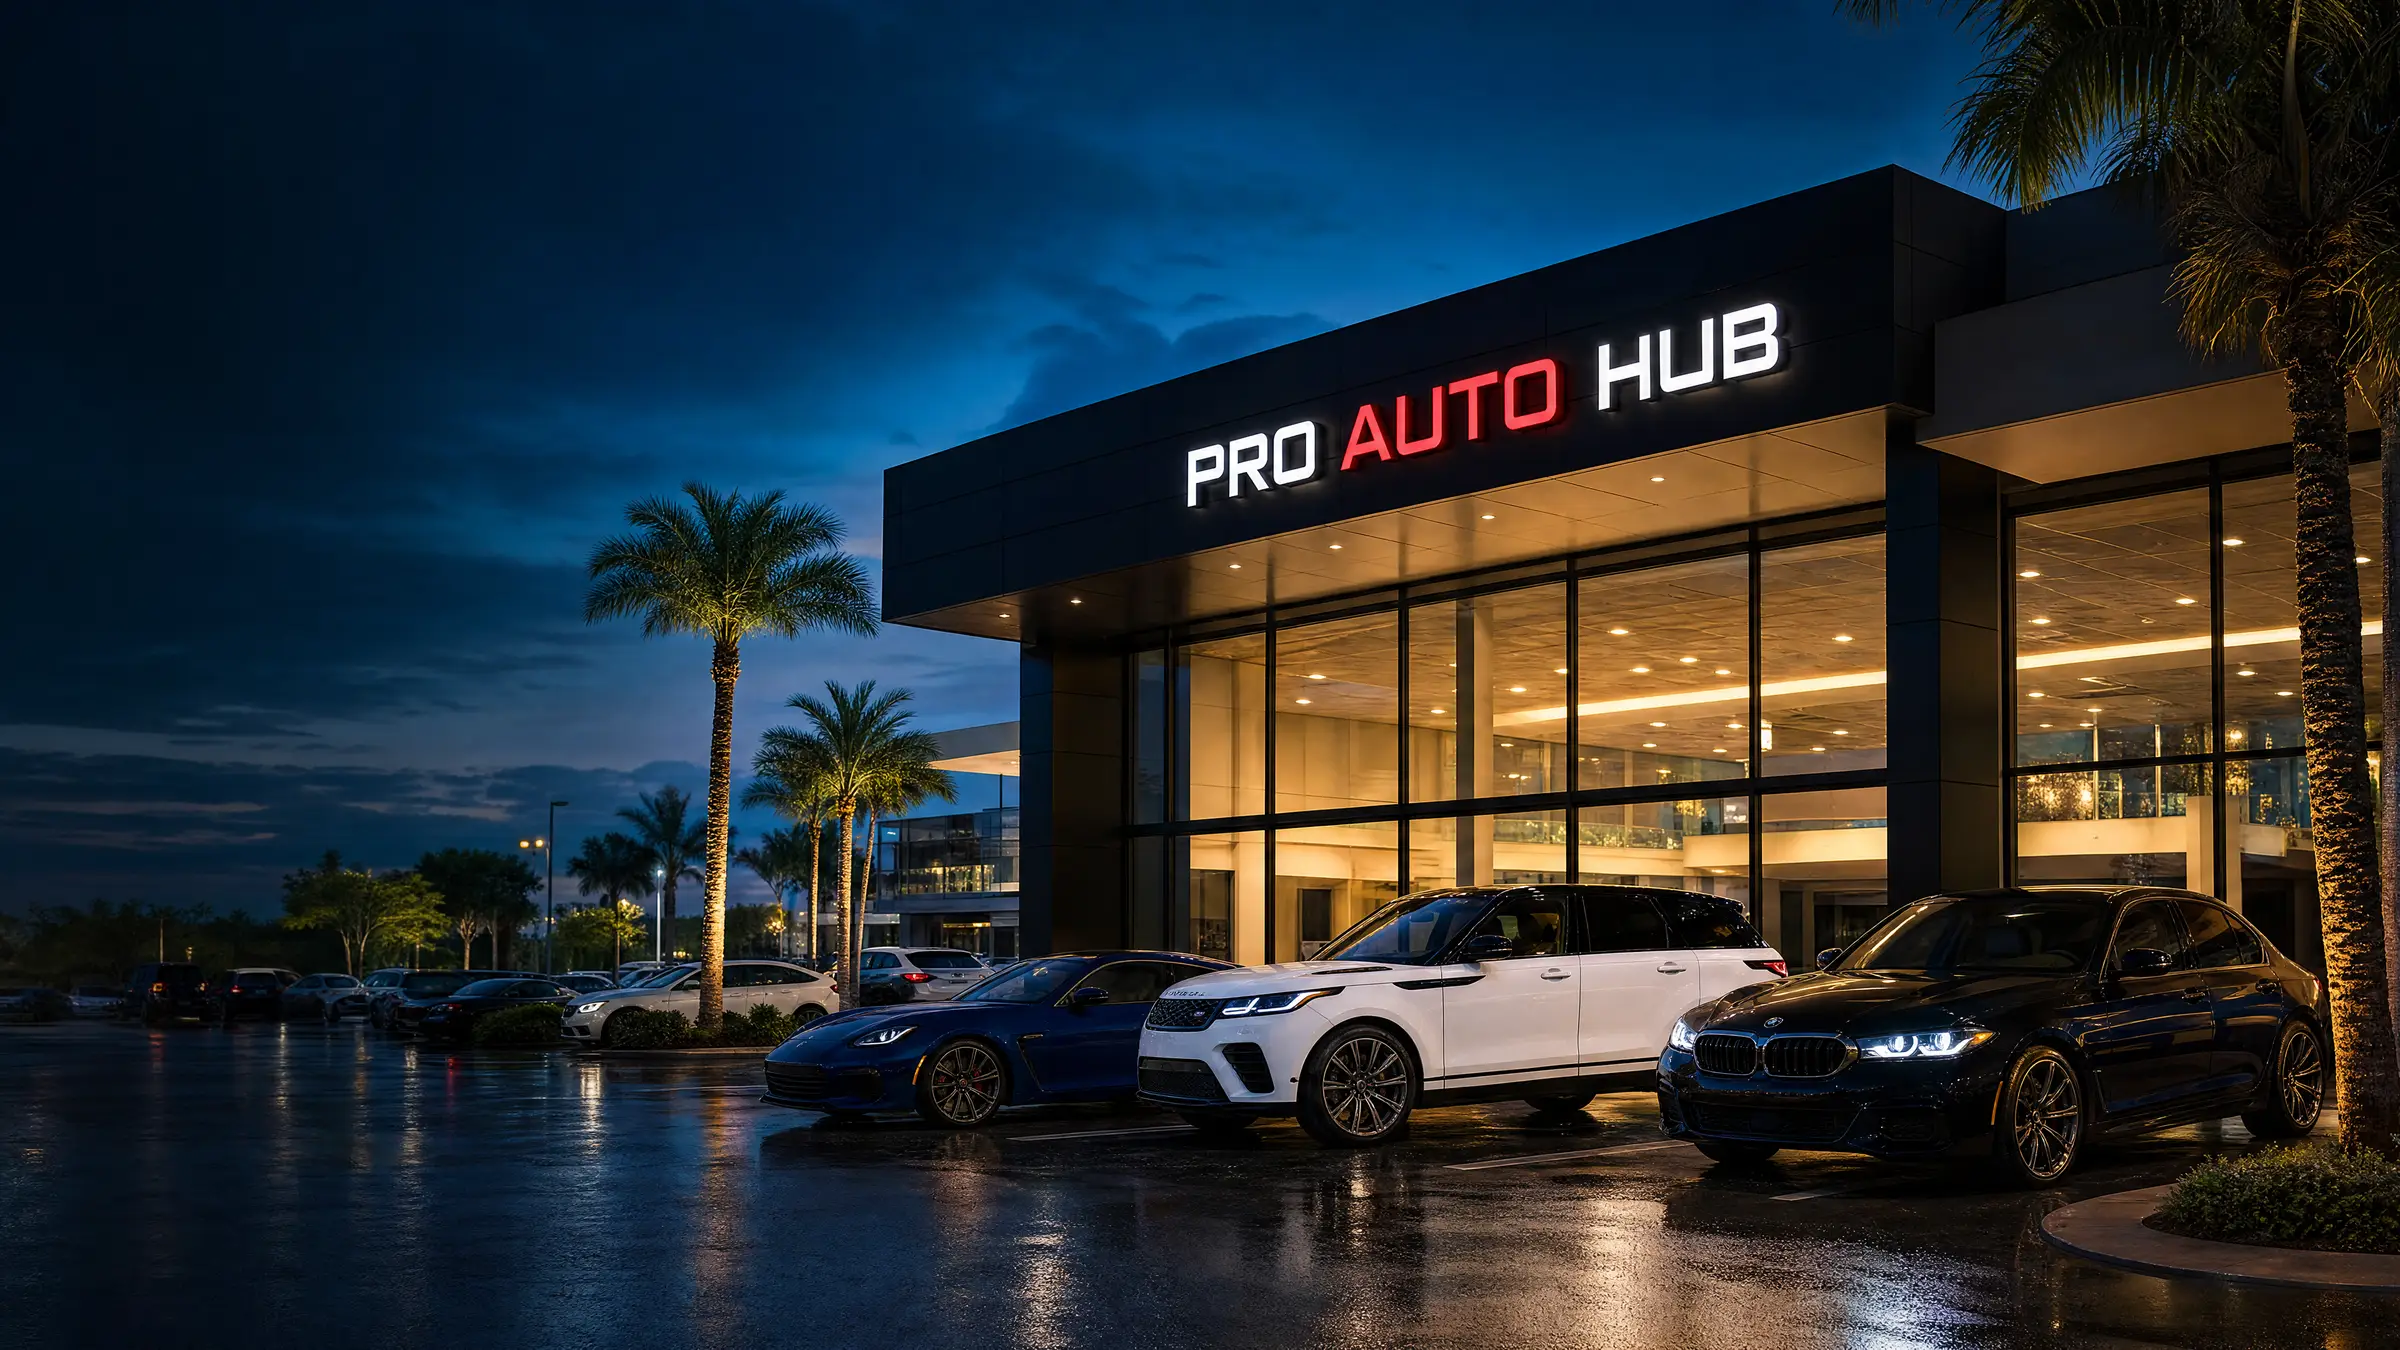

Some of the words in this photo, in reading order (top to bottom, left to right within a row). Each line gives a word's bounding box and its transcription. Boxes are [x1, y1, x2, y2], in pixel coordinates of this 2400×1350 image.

[1187, 420, 1316, 507] PRO
[1340, 358, 1559, 471] AUTO
[1598, 302, 1780, 411] HUB
